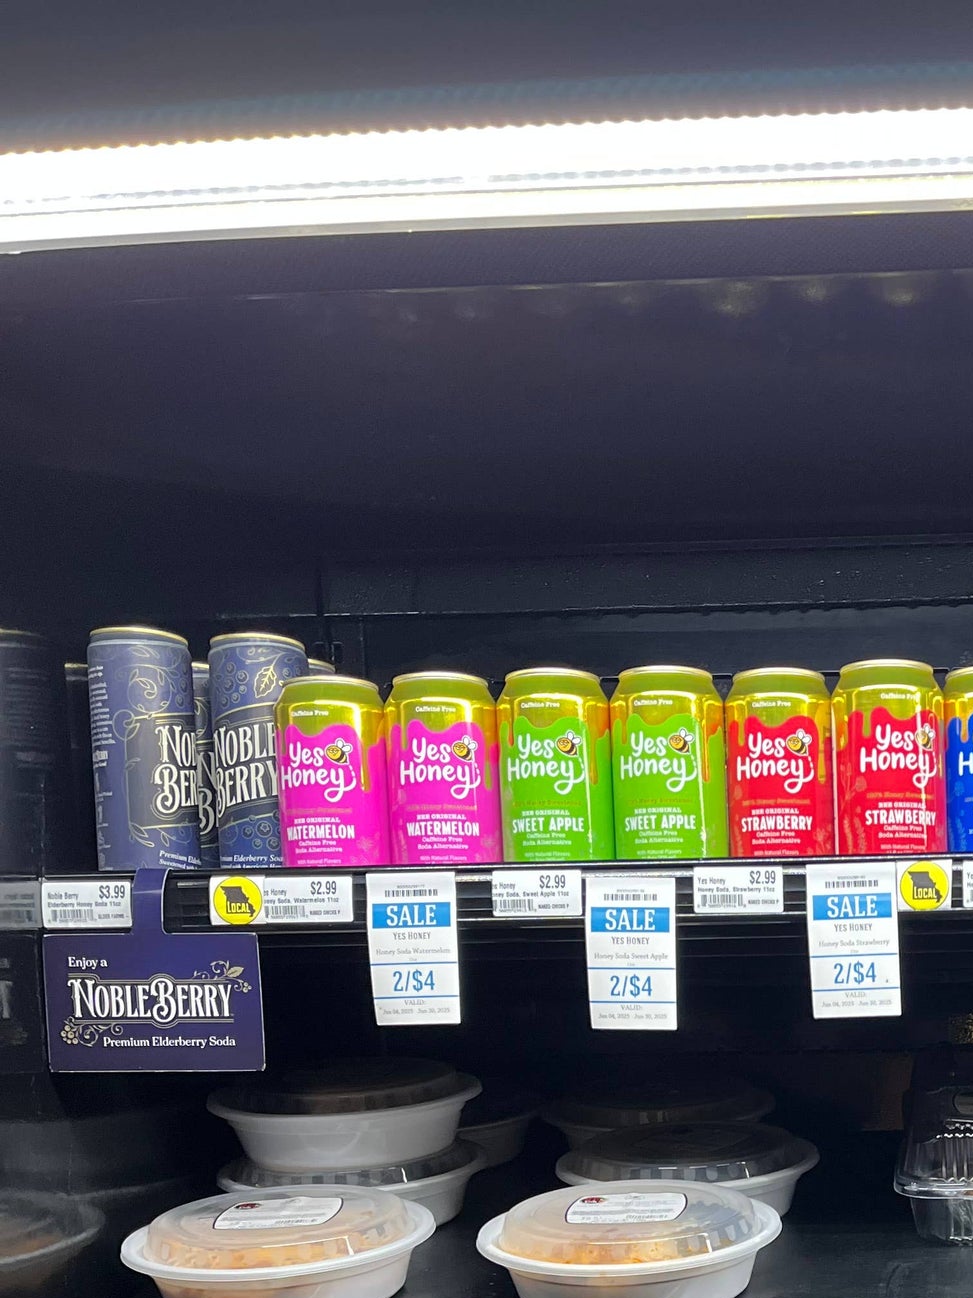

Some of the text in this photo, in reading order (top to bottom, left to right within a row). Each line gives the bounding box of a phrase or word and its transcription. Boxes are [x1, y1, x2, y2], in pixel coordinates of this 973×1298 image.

[517, 734, 554, 758] Yes
[631, 732, 668, 756] Yes
[748, 732, 785, 757] Yes
[875, 724, 914, 750] Yes
[289, 742, 324, 767] Yes
[412, 737, 451, 763] Yes
[507, 755, 585, 795] Honey
[620, 754, 697, 792] Honey
[737, 756, 814, 794] Honey
[860, 747, 937, 788] Honey
[281, 766, 356, 802] Honey
[401, 760, 480, 799] Honey
[513, 817, 585, 834] SWEET APPLE
[625, 815, 696, 830] SWEET APPLE
[741, 815, 812, 833] STRAWBERRY
[865, 810, 936, 826] STRAWBERRY
[287, 825, 355, 840] WATERMELON
[407, 822, 480, 836] WATERMELON
[499, 874, 566, 890] Honey $2.99
[698, 870, 776, 886] Yes Honey $2.99
[65, 892, 79, 901] Berry
[99, 885, 125, 899] $3.99
[271, 888, 287, 897] Honey
[310, 881, 337, 896] $2.99
[913, 886, 937, 900] LOCAL
[48, 900, 72, 909] Elderberry
[74, 901, 93, 909] Honey
[227, 901, 251, 914] LOCAL
[827, 895, 878, 919] SALE
[386, 904, 437, 926] SALE
[605, 909, 656, 931] SALE
[393, 931, 431, 940] YES HONEY
[834, 923, 873, 932] YES HONEY
[611, 937, 650, 945] YES HONEY
[68, 957, 108, 969] Enjoy a
[392, 969, 436, 992] 2/$4
[833, 962, 877, 985] 2/$4
[610, 974, 653, 998] 2/$4
[103, 1036, 236, 1048] Premium Elderberry Soda
